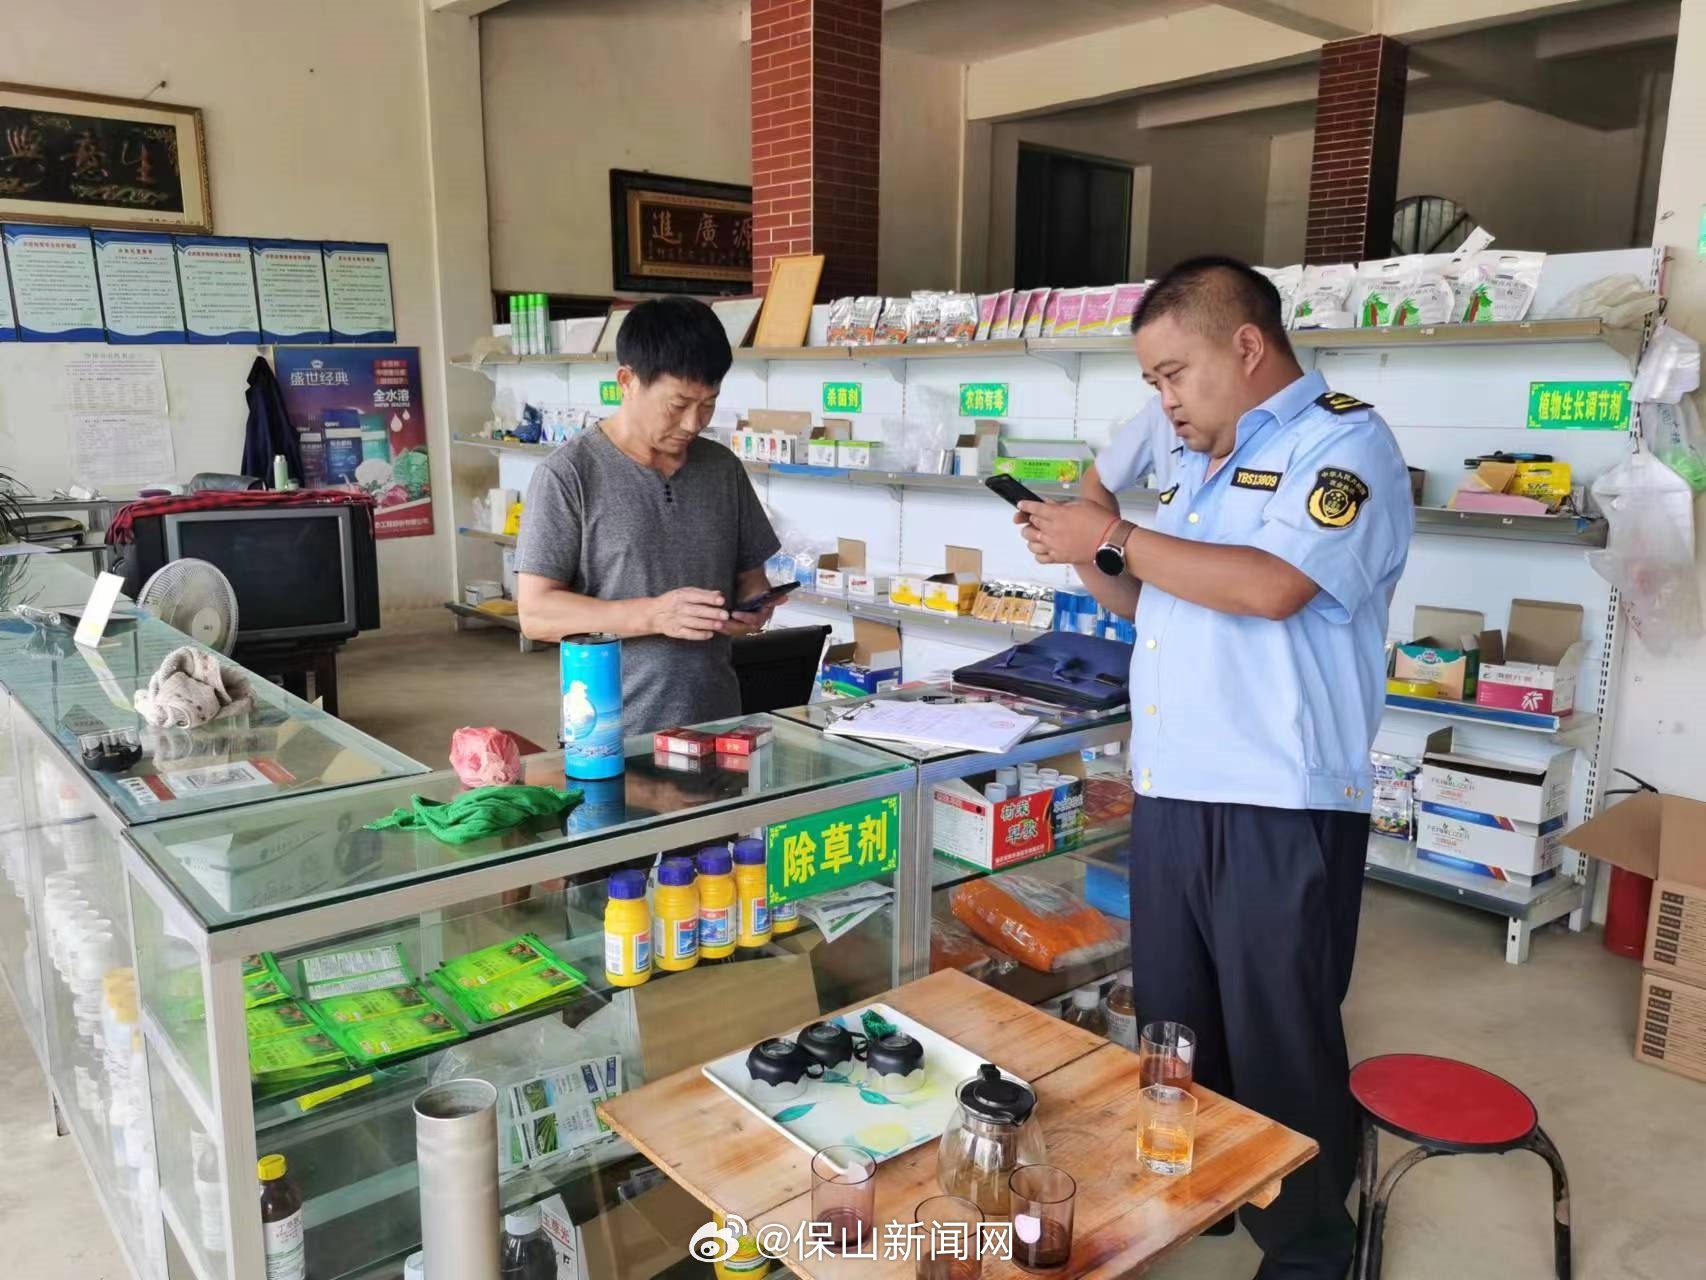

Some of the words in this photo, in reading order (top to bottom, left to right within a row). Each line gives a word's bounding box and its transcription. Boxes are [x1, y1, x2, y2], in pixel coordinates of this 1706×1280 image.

[290, 371, 349, 386] 盛世经典
[827, 388, 858, 407] 杀菌剂
[967, 388, 1003, 411] 农药有毒
[1539, 390, 1622, 421] 植物生长调节剂
[783, 812, 888, 887] 除草剂
